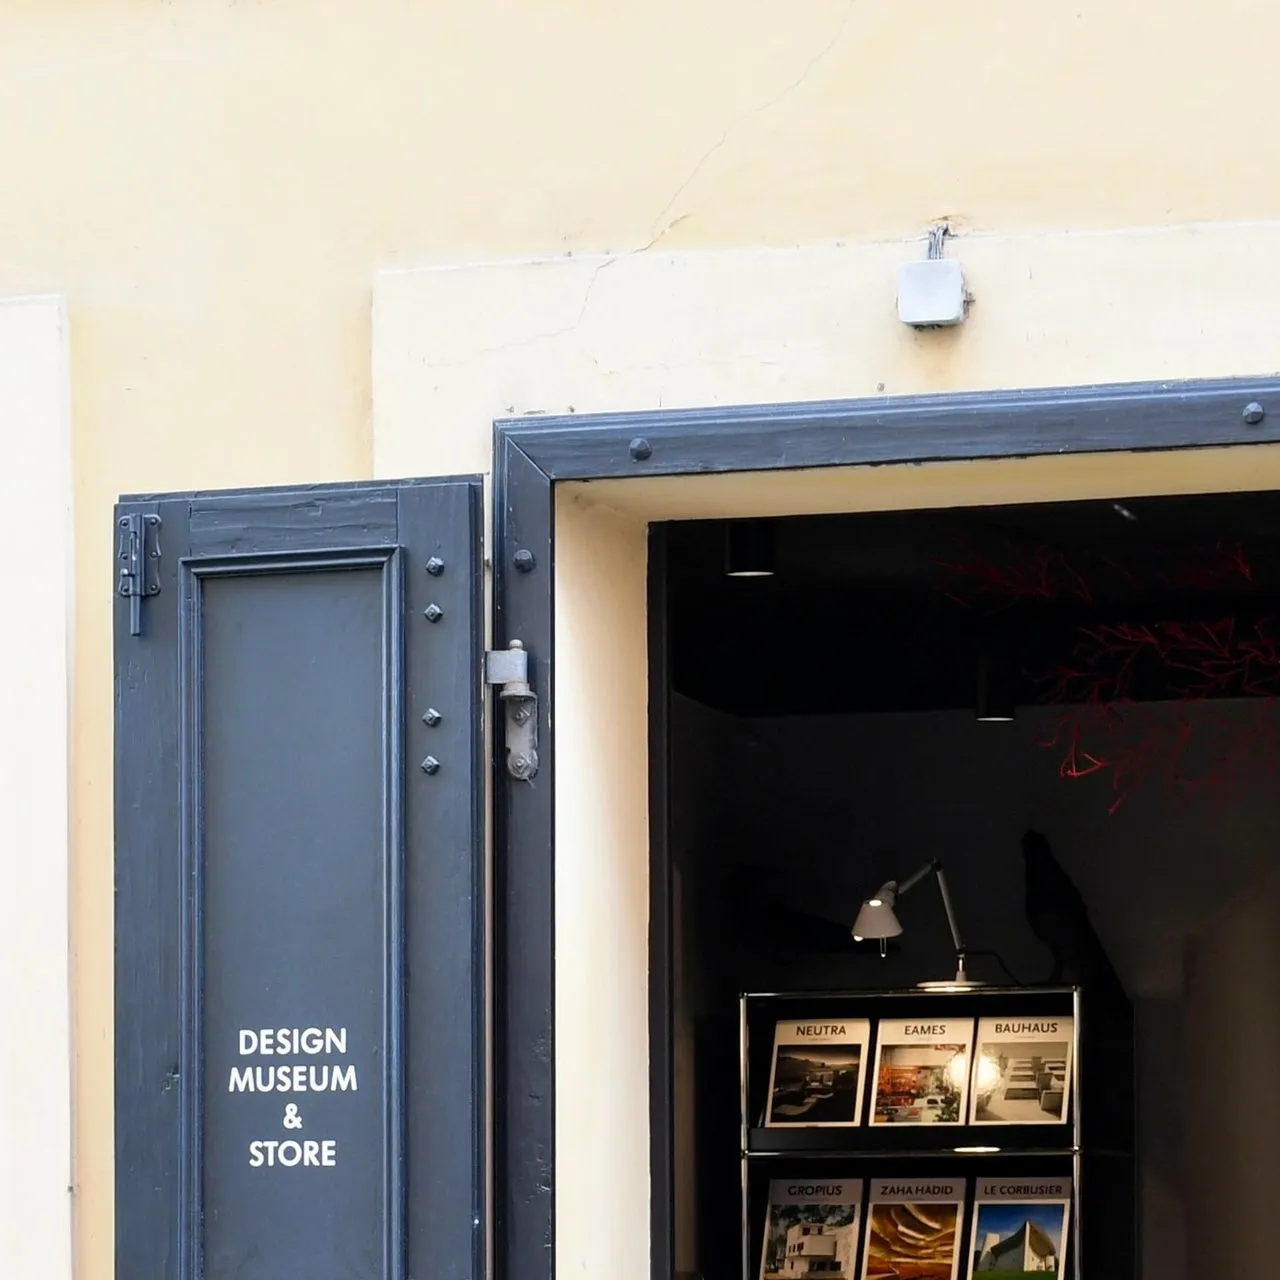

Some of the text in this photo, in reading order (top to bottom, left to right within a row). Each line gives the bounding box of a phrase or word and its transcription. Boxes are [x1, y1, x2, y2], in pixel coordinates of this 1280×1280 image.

[796, 1025, 847, 1036] NEUTRA
[904, 1024, 947, 1035] EAMES
[994, 1022, 1059, 1034] BAUHAUS
[239, 1027, 347, 1055] DESIGN
[228, 1065, 358, 1093] MUSEUM
[283, 1102, 303, 1129] &
[249, 1140, 336, 1167] STORE
[788, 1185, 842, 1197] GROPIUS
[880, 1185, 953, 1196] ZAHA HADID
[983, 1185, 1063, 1196] LE CORBUSIER
